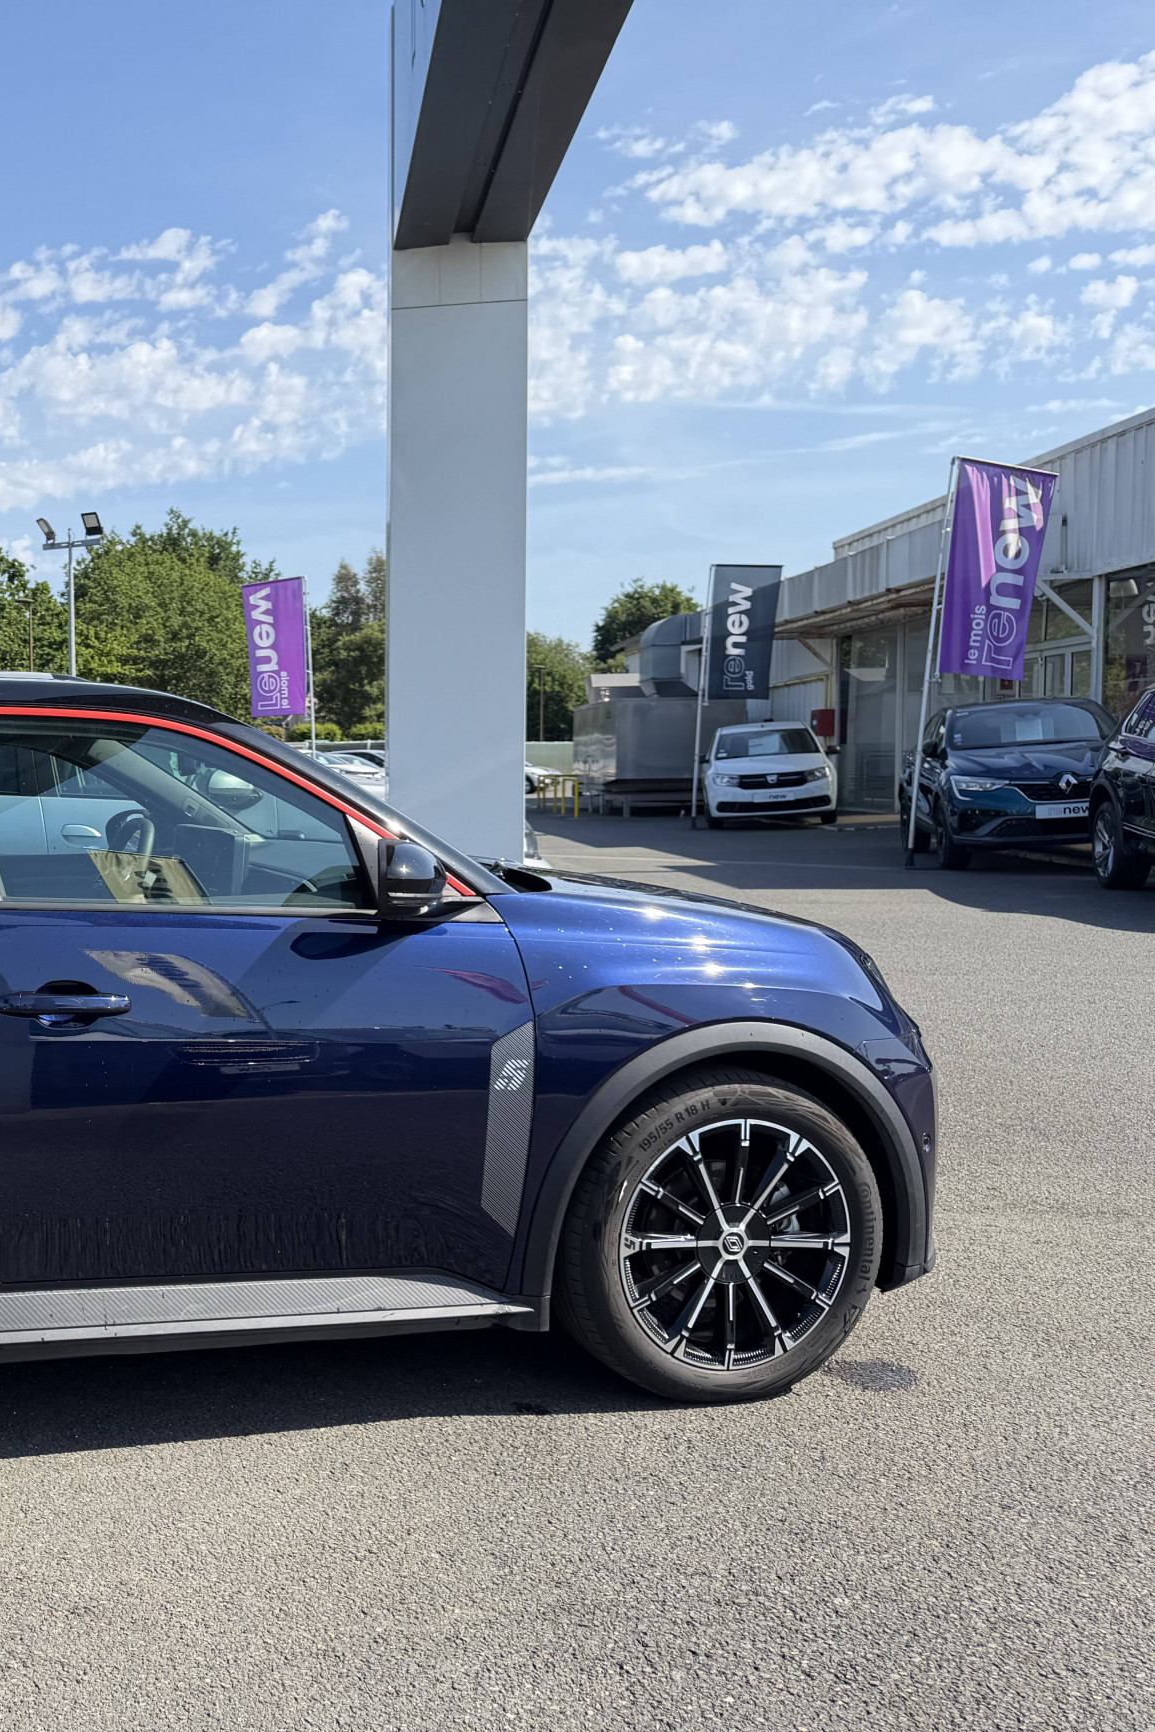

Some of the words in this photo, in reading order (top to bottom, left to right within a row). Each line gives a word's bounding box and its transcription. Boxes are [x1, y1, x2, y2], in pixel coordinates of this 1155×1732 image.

[982, 474, 1043, 670] renew
[723, 582, 753, 690] renew
[968, 604, 986, 647] mois
[745, 670, 754, 690] gold
[965, 647, 978, 664] le
[638, 1118, 674, 1152] 195/55
[674, 1111, 685, 1123] R
[685, 1104, 699, 1117] 18
[700, 1100, 711, 1111] H
[857, 1181, 876, 1281] Continental
